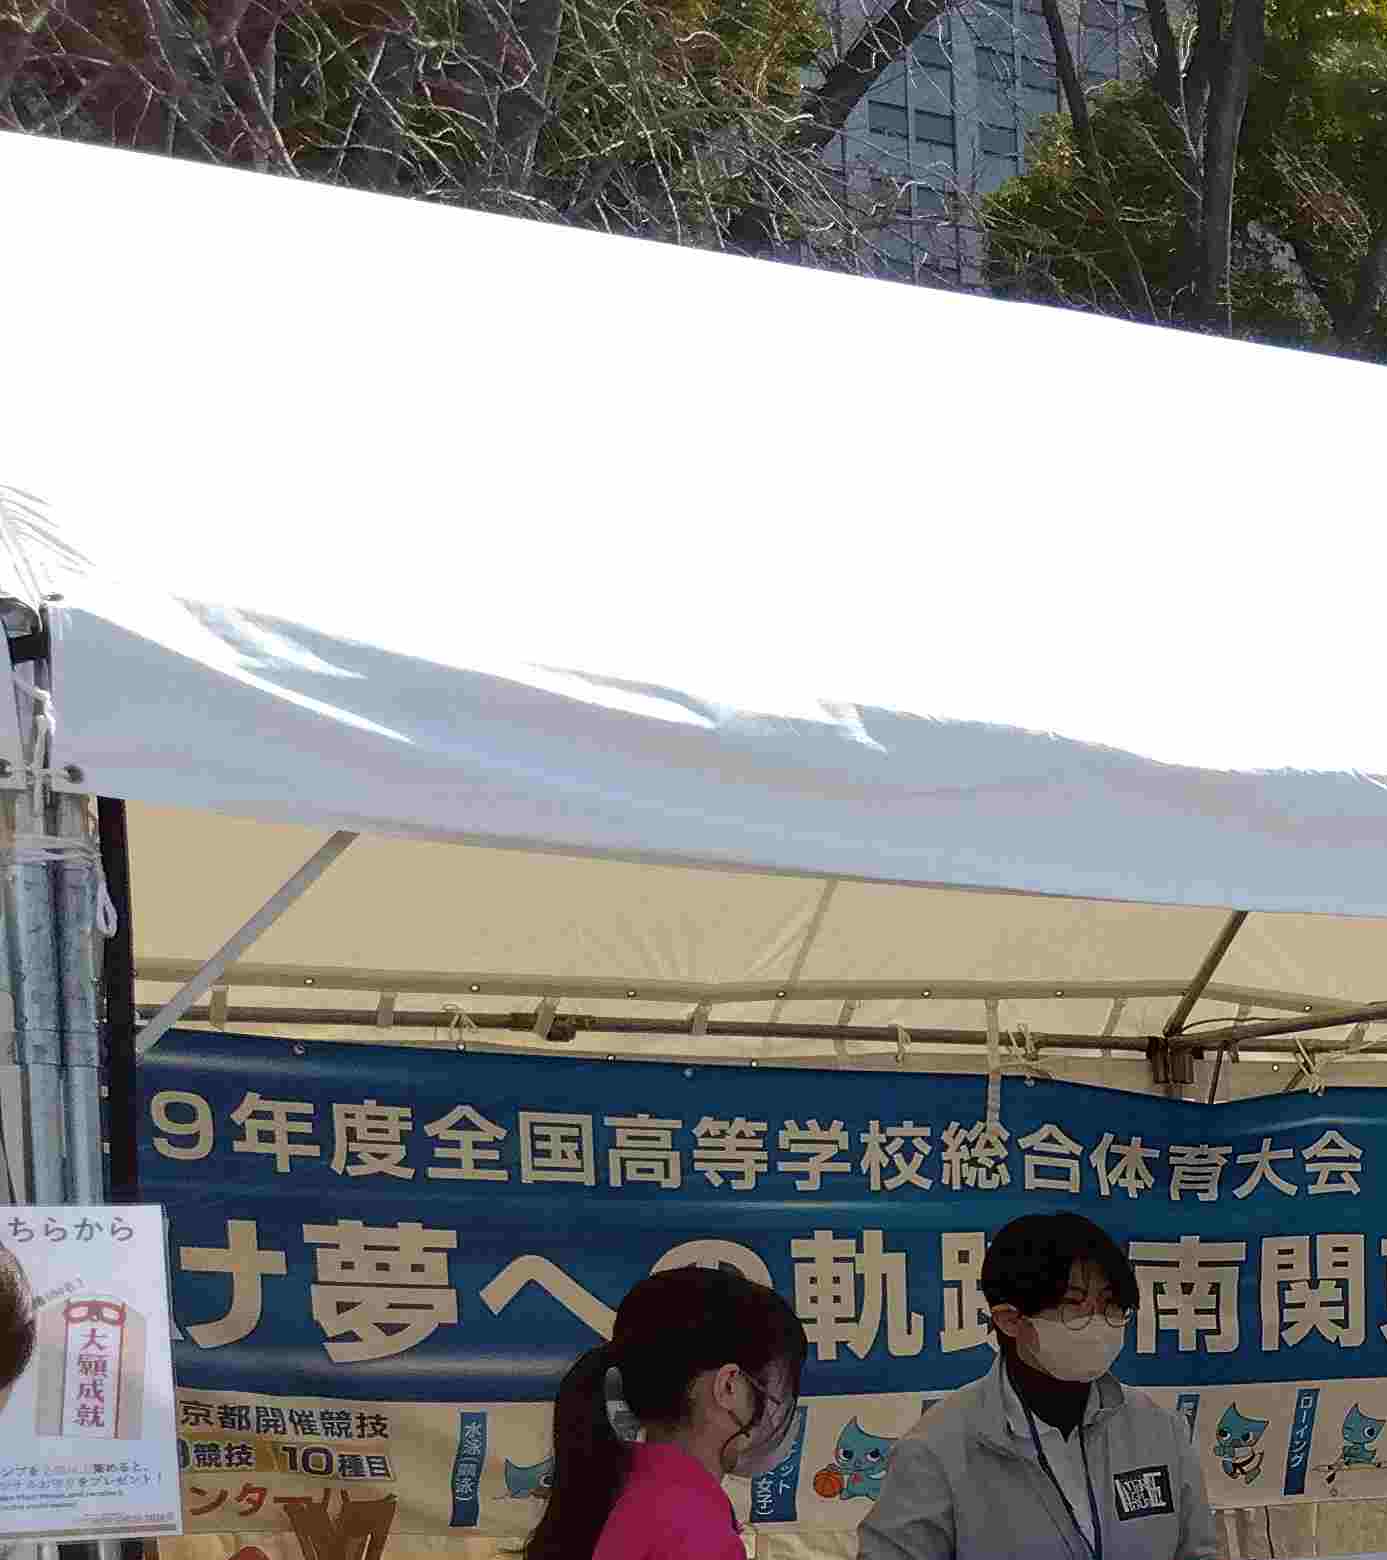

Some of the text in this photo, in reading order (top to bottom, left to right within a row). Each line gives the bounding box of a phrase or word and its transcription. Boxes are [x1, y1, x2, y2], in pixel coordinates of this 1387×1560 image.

[150, 1090, 1364, 1201] 9年度全国高等学校総合体育大会
